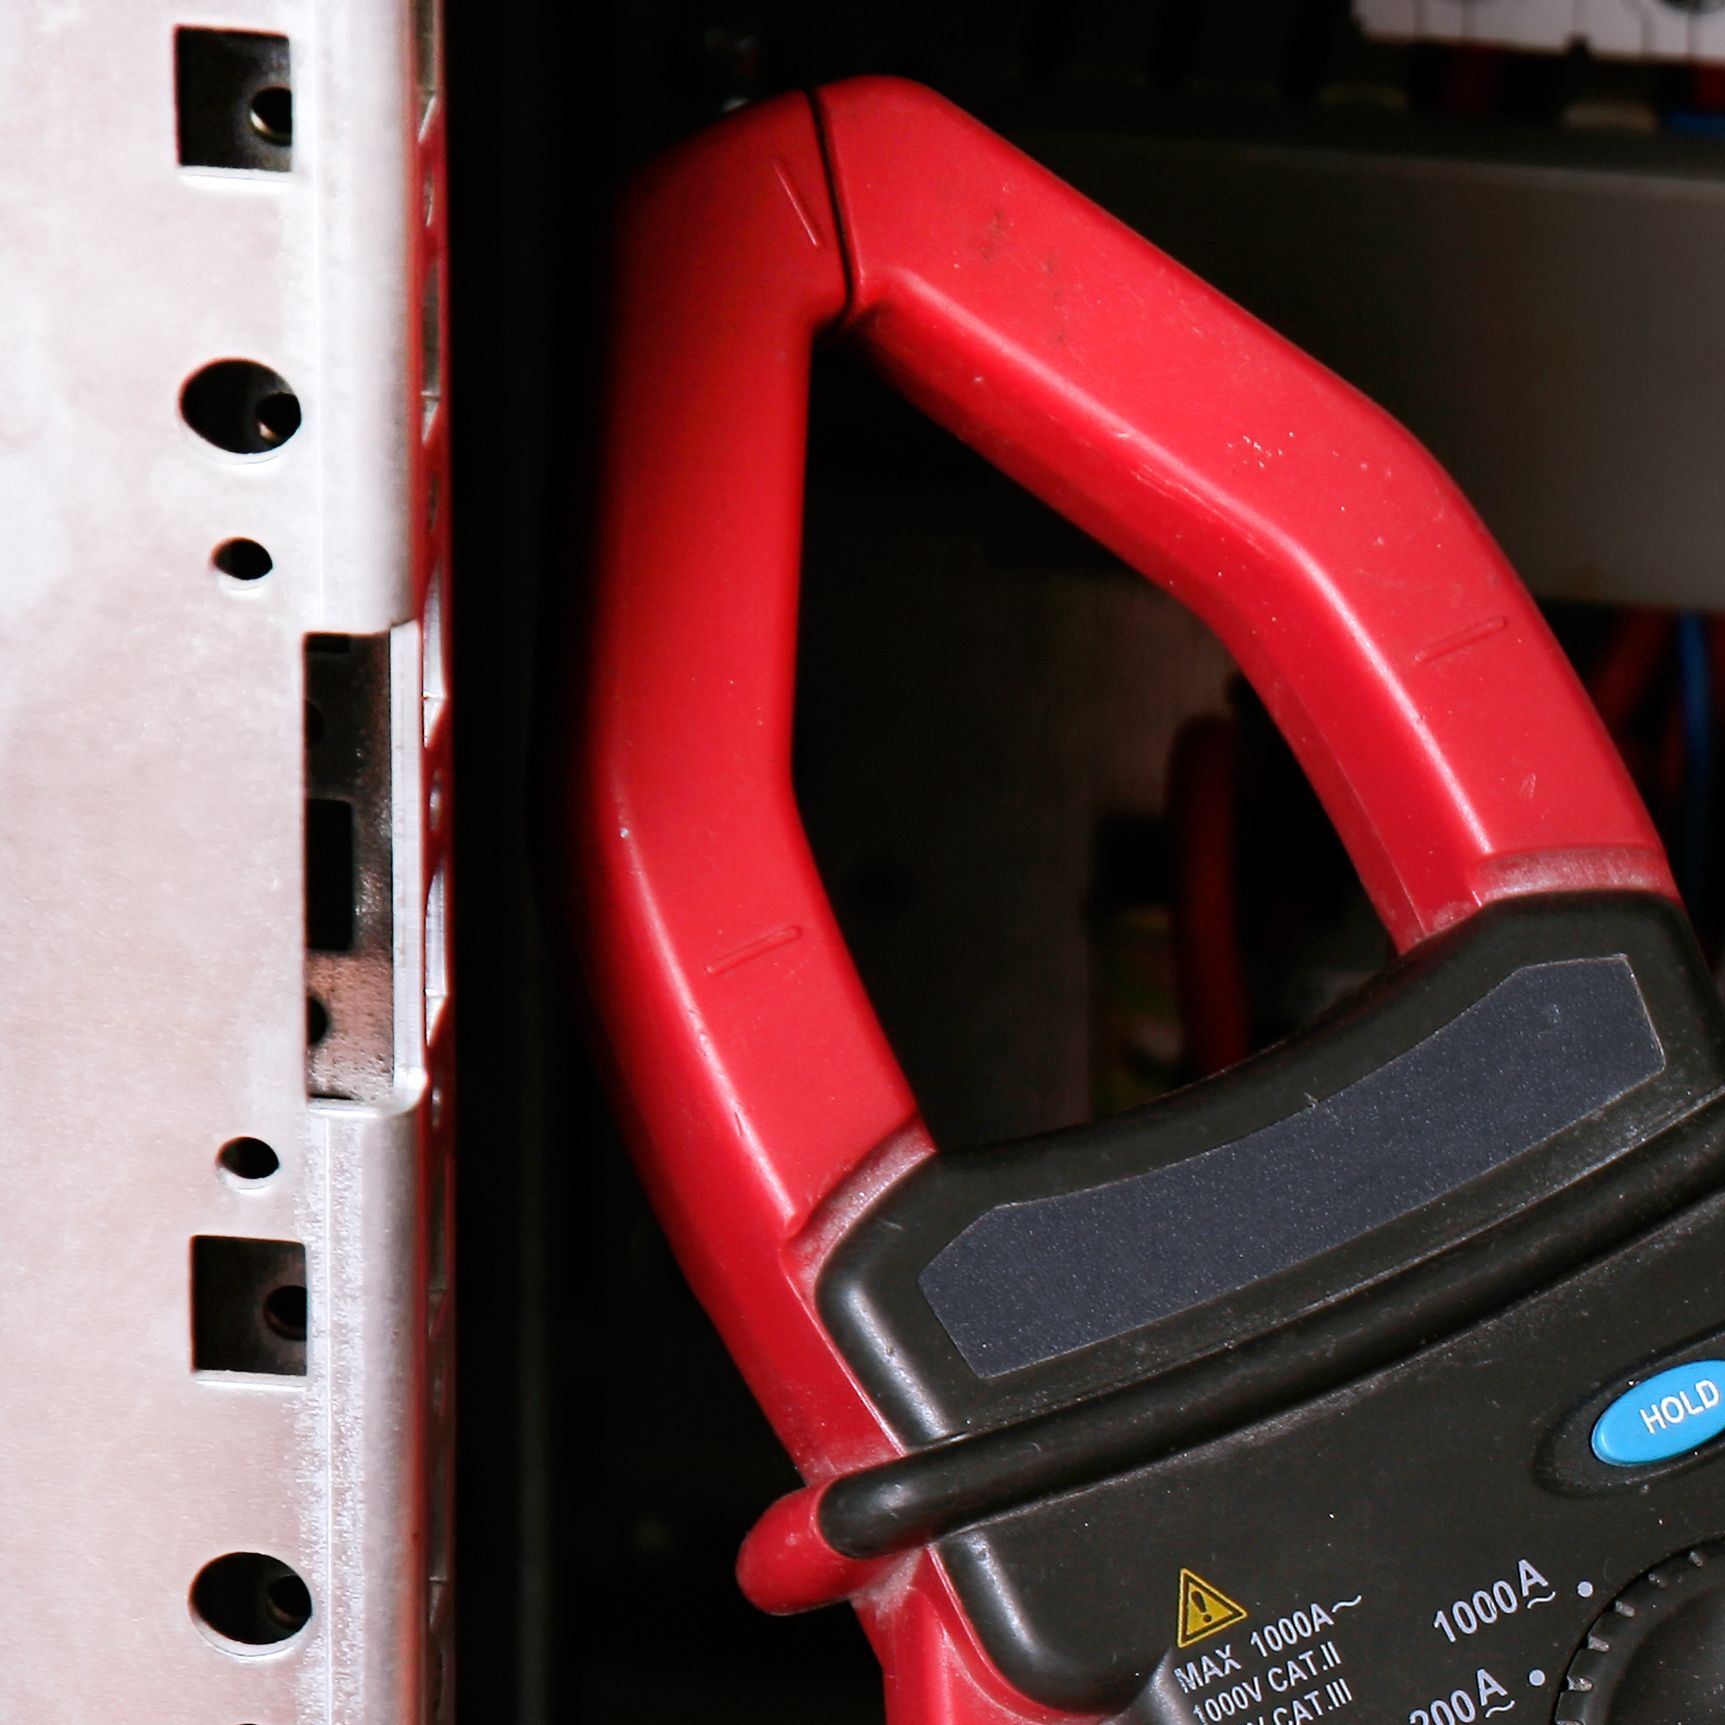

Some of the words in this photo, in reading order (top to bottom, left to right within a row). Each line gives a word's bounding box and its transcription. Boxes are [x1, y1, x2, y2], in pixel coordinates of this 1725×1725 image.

[1640, 1379, 1720, 1434] HOLD
[1433, 1559, 1551, 1642] 1000A
[1173, 1644, 1241, 1693] MAX
[1267, 1641, 1342, 1692] CAT.II
